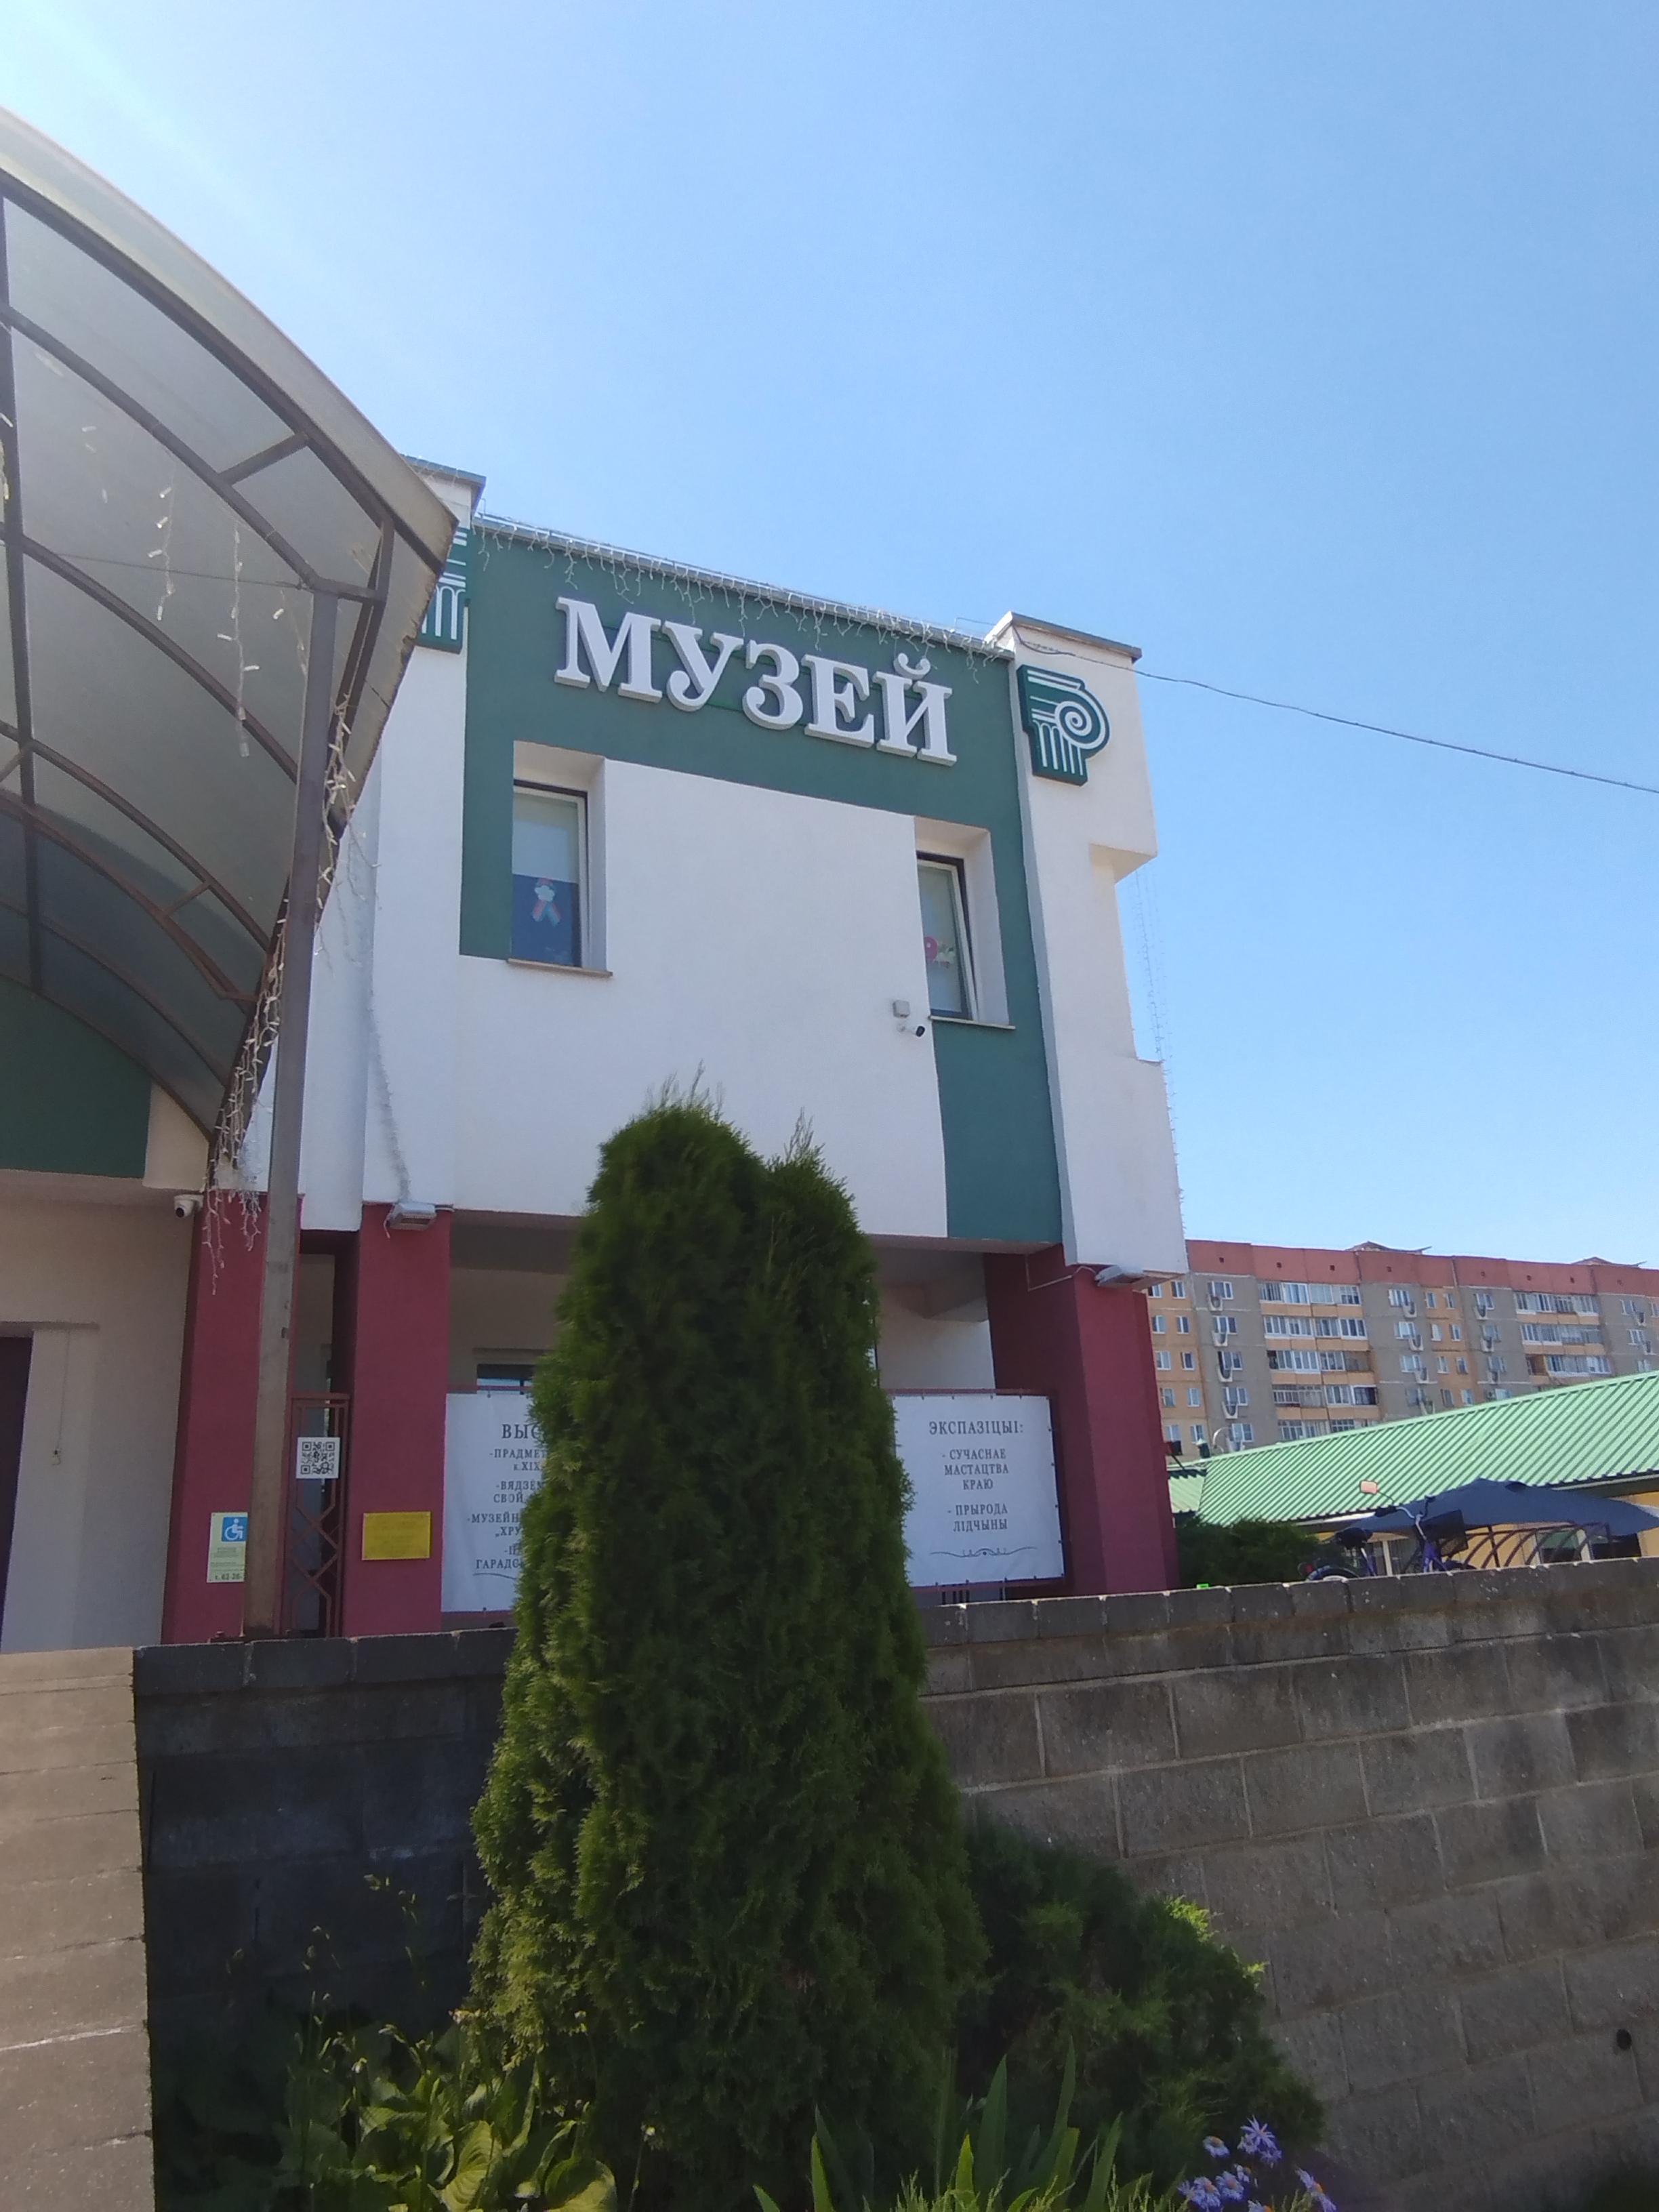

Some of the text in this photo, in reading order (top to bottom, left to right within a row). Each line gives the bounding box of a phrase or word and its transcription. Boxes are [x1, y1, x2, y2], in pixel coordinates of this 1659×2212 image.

[554, 596, 957, 766] МУЗЕЙ
[501, 1424, 539, 1439] ВЫС
[929, 1420, 1023, 1435] ЭКСПАЗІЦЫІ:
[944, 1463, 1009, 1475] МАСТАЦТВА
[962, 1478, 994, 1490] КРАЮ
[493, 1492, 523, 1503] СВОЙ
[953, 1519, 1008, 1532] ЛІДЧЫНЫ
[476, 1559, 520, 1570] ГАРАДС
